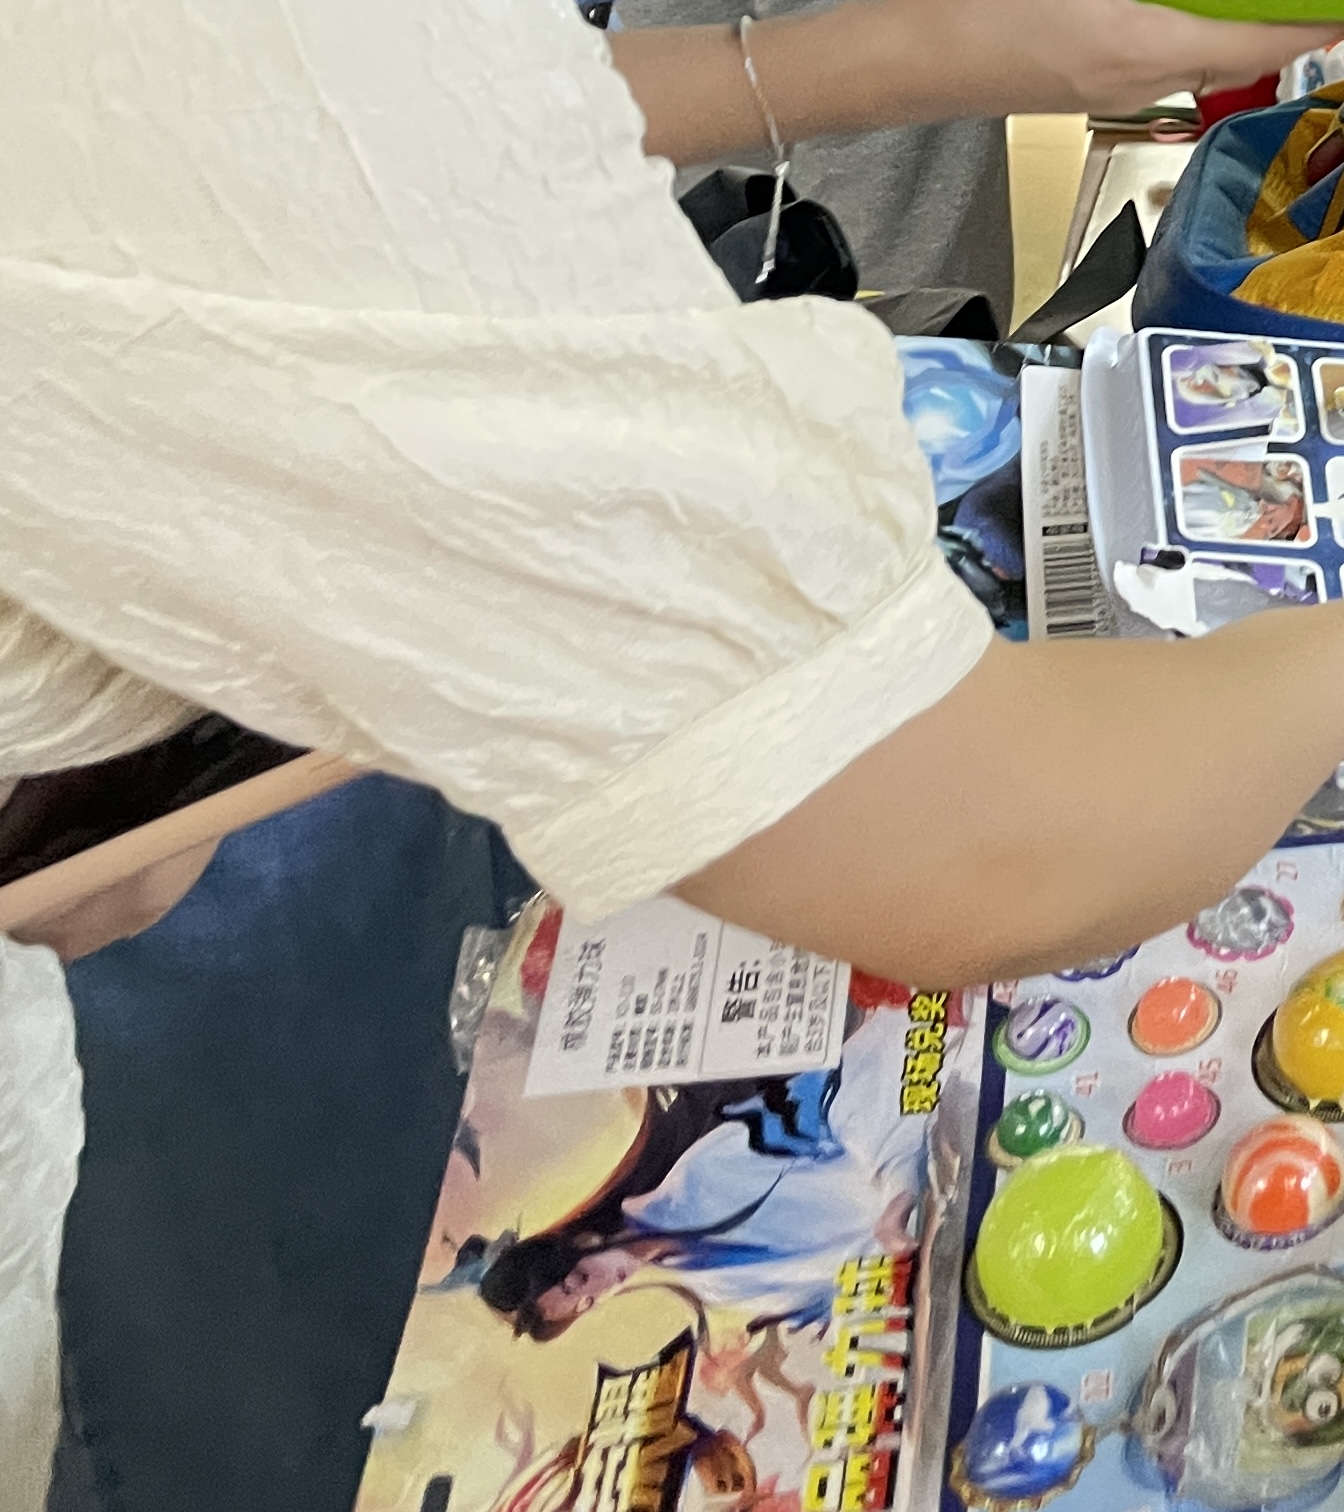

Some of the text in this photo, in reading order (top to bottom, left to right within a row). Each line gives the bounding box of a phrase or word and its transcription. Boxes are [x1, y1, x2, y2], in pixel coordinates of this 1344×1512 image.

[719, 958, 762, 1023] 警告:
[899, 990, 950, 1117] 现场兑奖
[1074, 1070, 1099, 1098] 41
